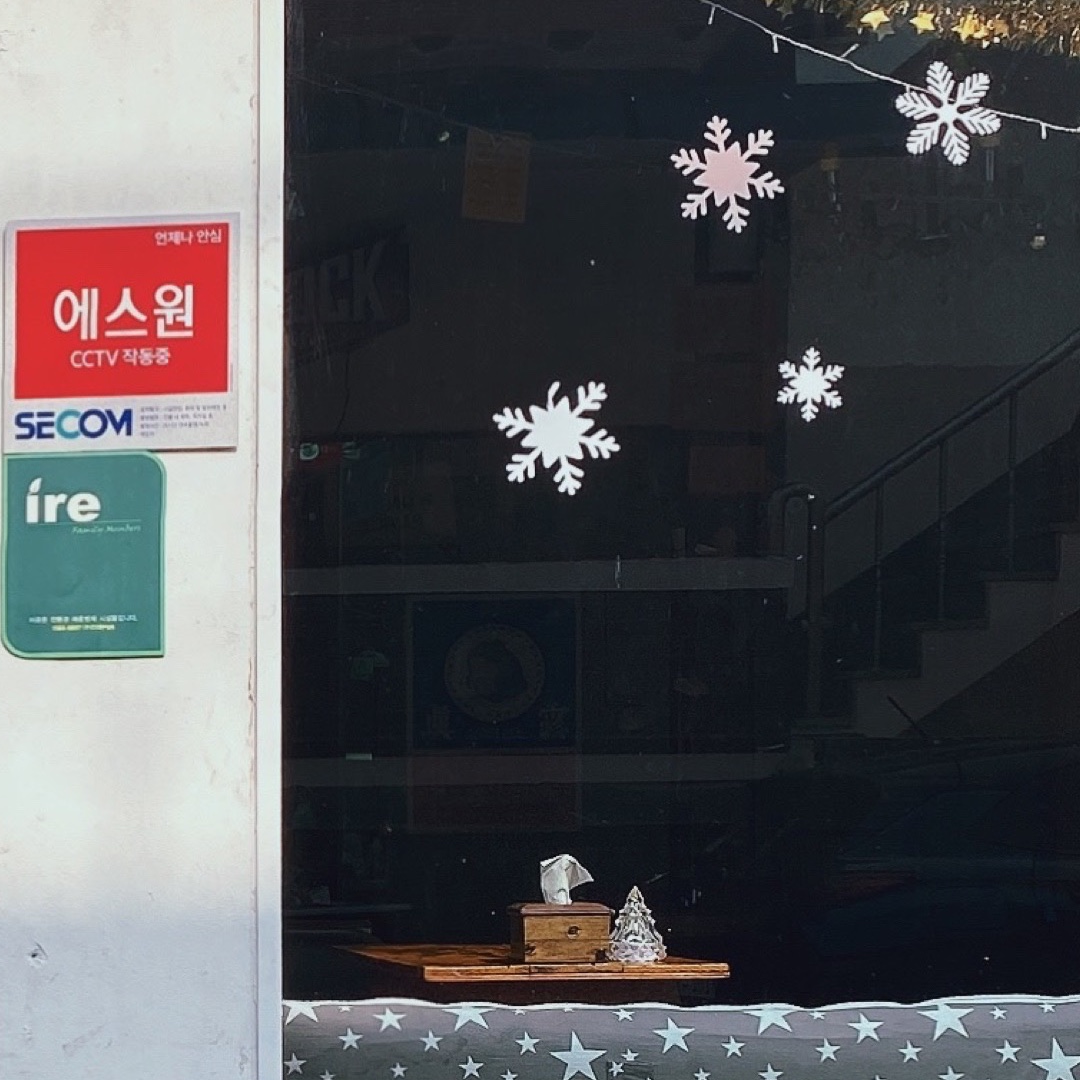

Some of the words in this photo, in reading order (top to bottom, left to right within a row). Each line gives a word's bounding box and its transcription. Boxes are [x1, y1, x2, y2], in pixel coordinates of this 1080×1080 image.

[154, 229, 193, 247] 언제나
[196, 227, 223, 244] 안심
[53, 283, 194, 341] 에스원
[69, 349, 120, 370] CCTV
[122, 346, 172, 366] 작동중
[14, 408, 133, 441] SECOM
